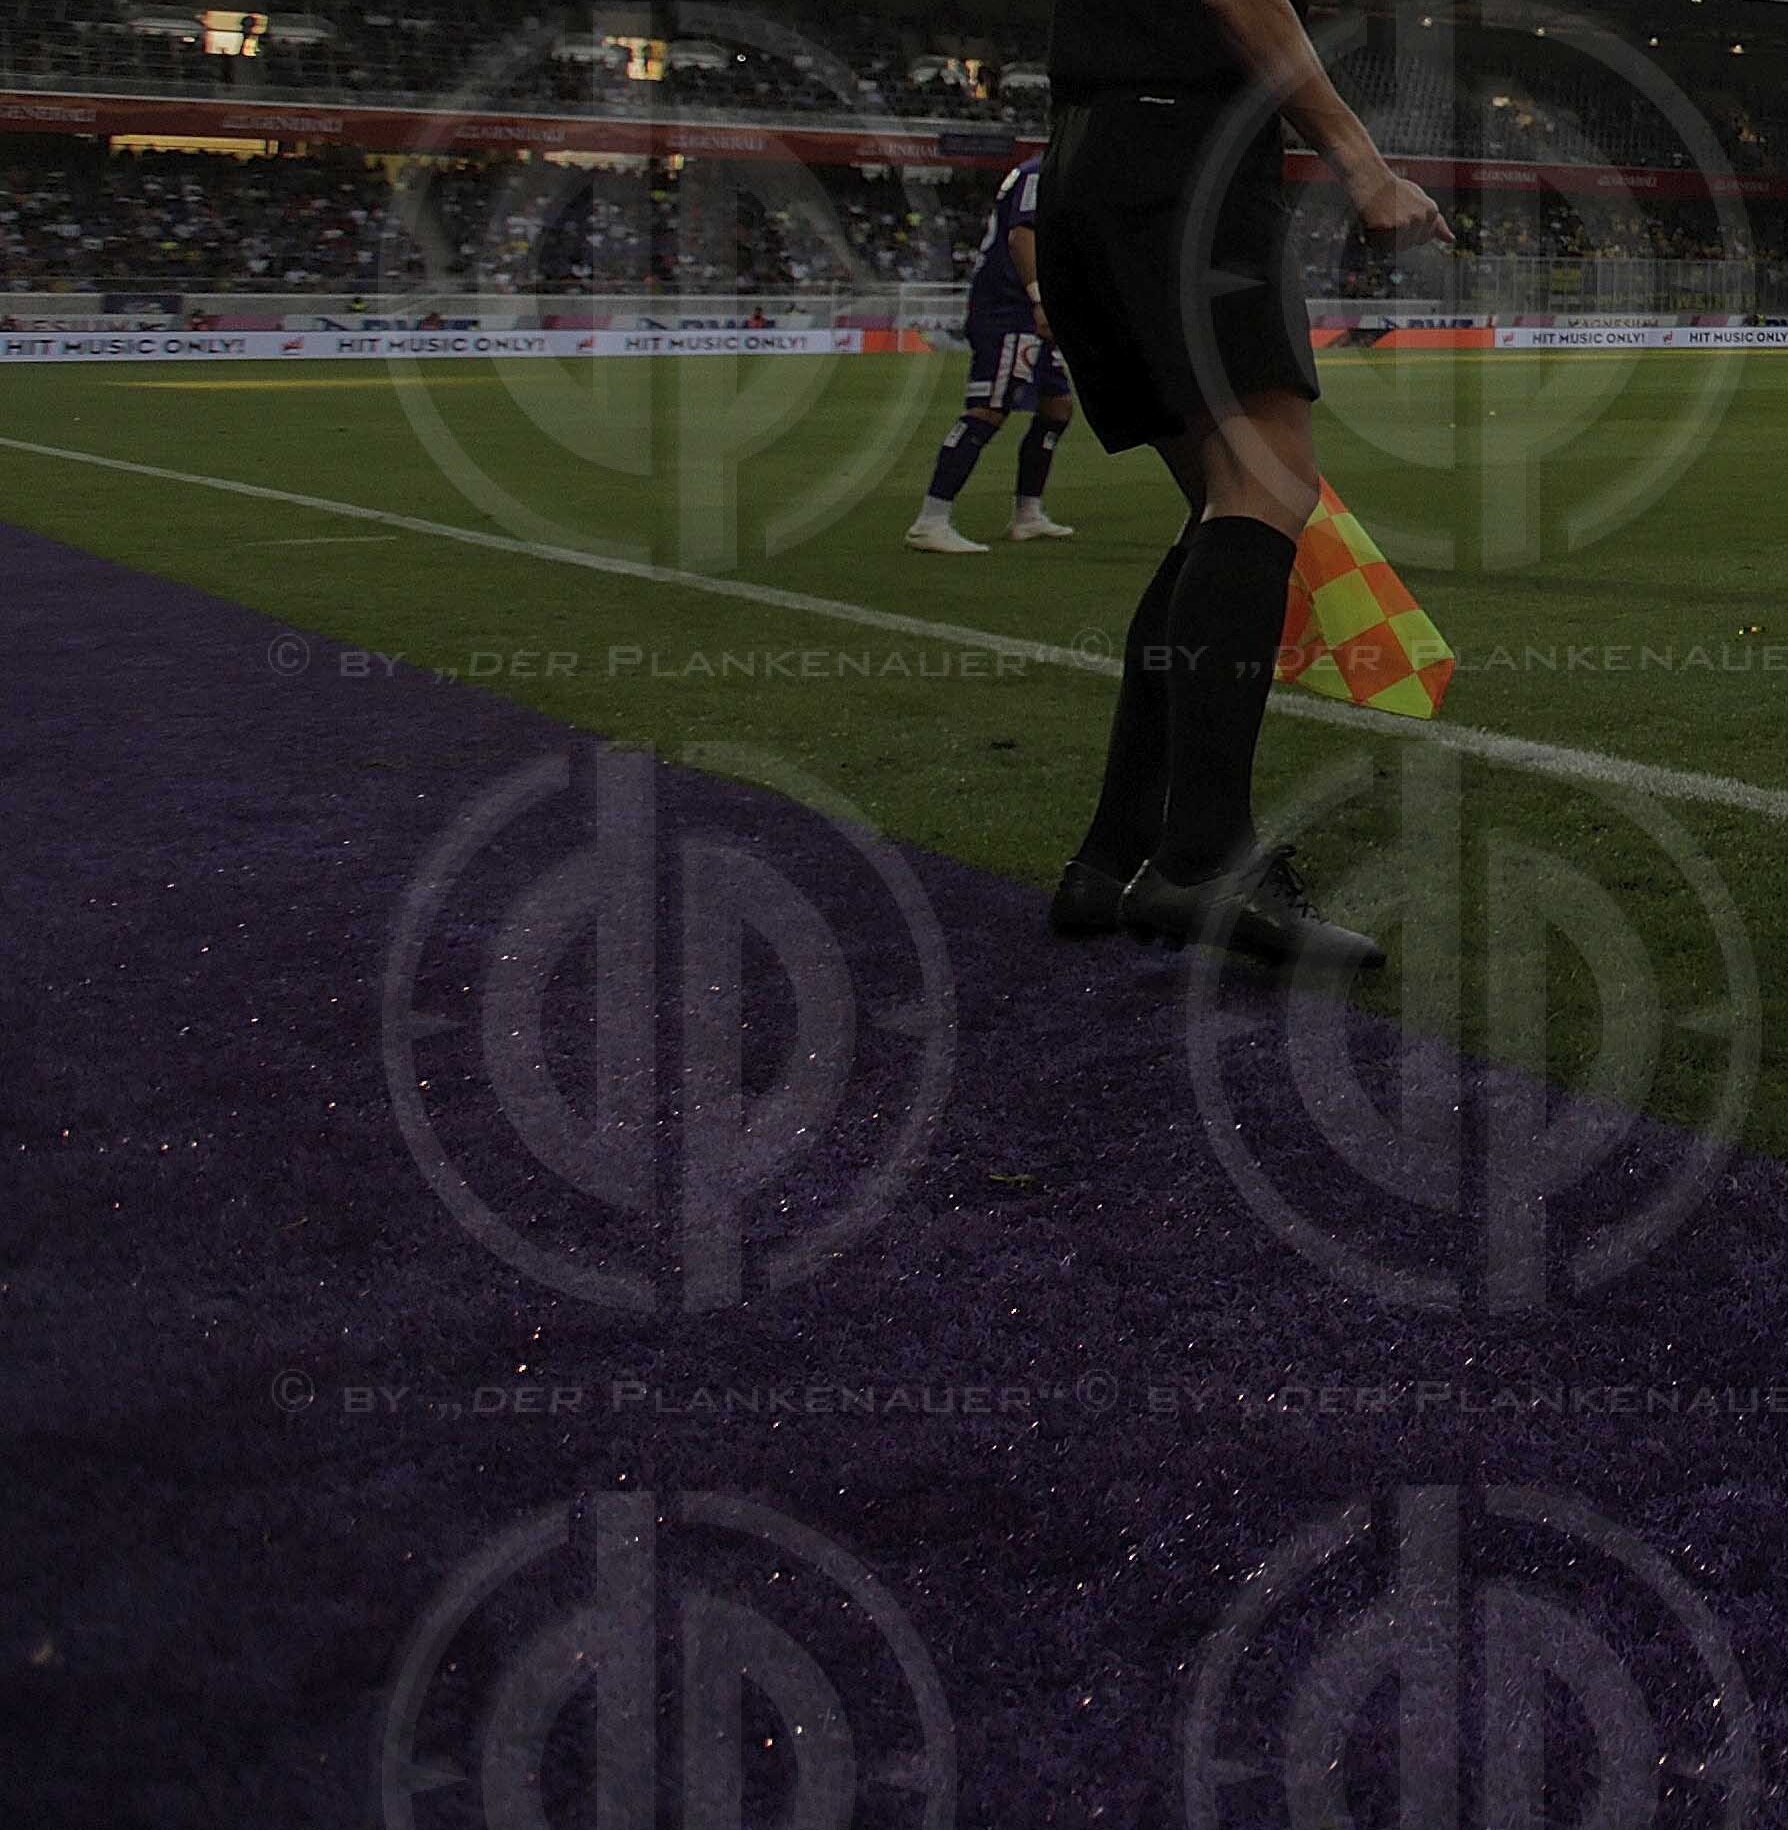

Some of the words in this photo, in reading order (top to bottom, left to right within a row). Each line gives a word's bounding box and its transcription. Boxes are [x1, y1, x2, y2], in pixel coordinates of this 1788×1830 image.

[1532, 333, 1555, 344] HIT
[1560, 333, 1604, 344] MUSIC
[1607, 333, 1645, 344] ONLY!
[1689, 332, 1710, 343] HIT
[1714, 332, 1754, 343] MUSIC
